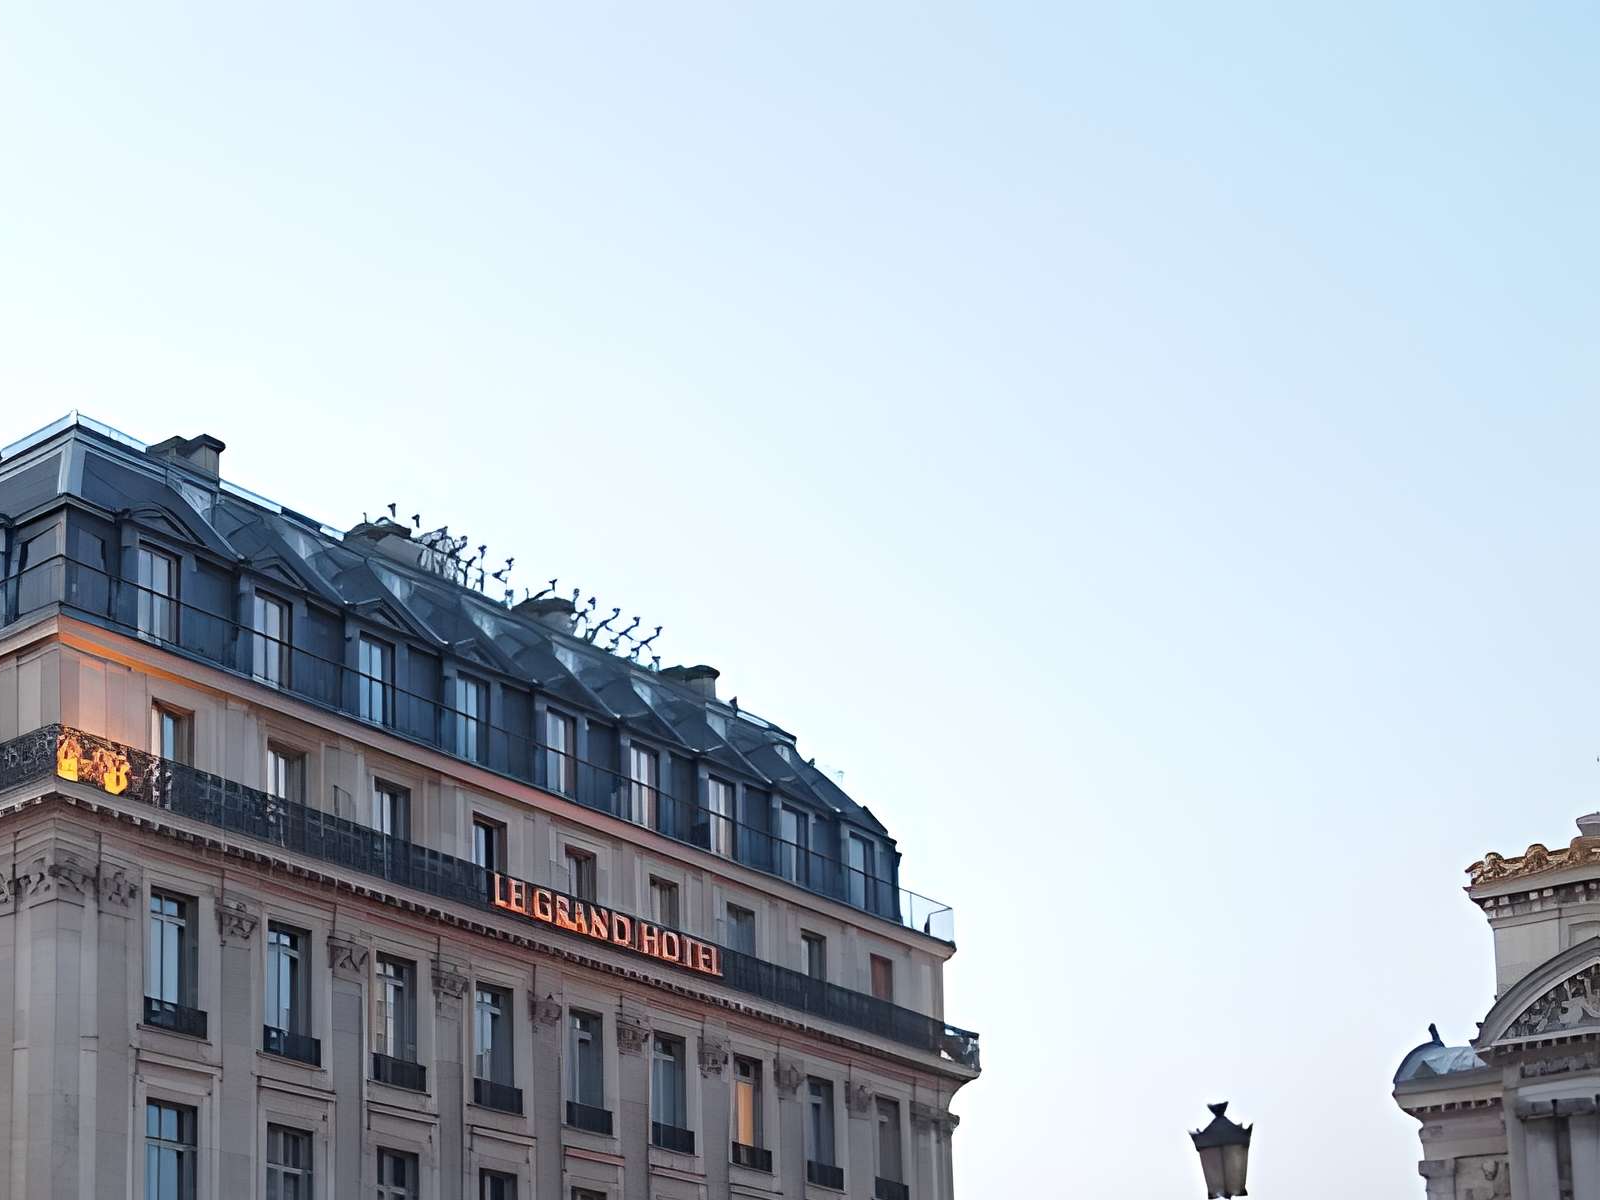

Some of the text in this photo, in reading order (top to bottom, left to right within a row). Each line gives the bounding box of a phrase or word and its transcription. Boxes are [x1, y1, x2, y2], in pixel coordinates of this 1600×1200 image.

[494, 872, 723, 977] LE GRAND HOTEL
